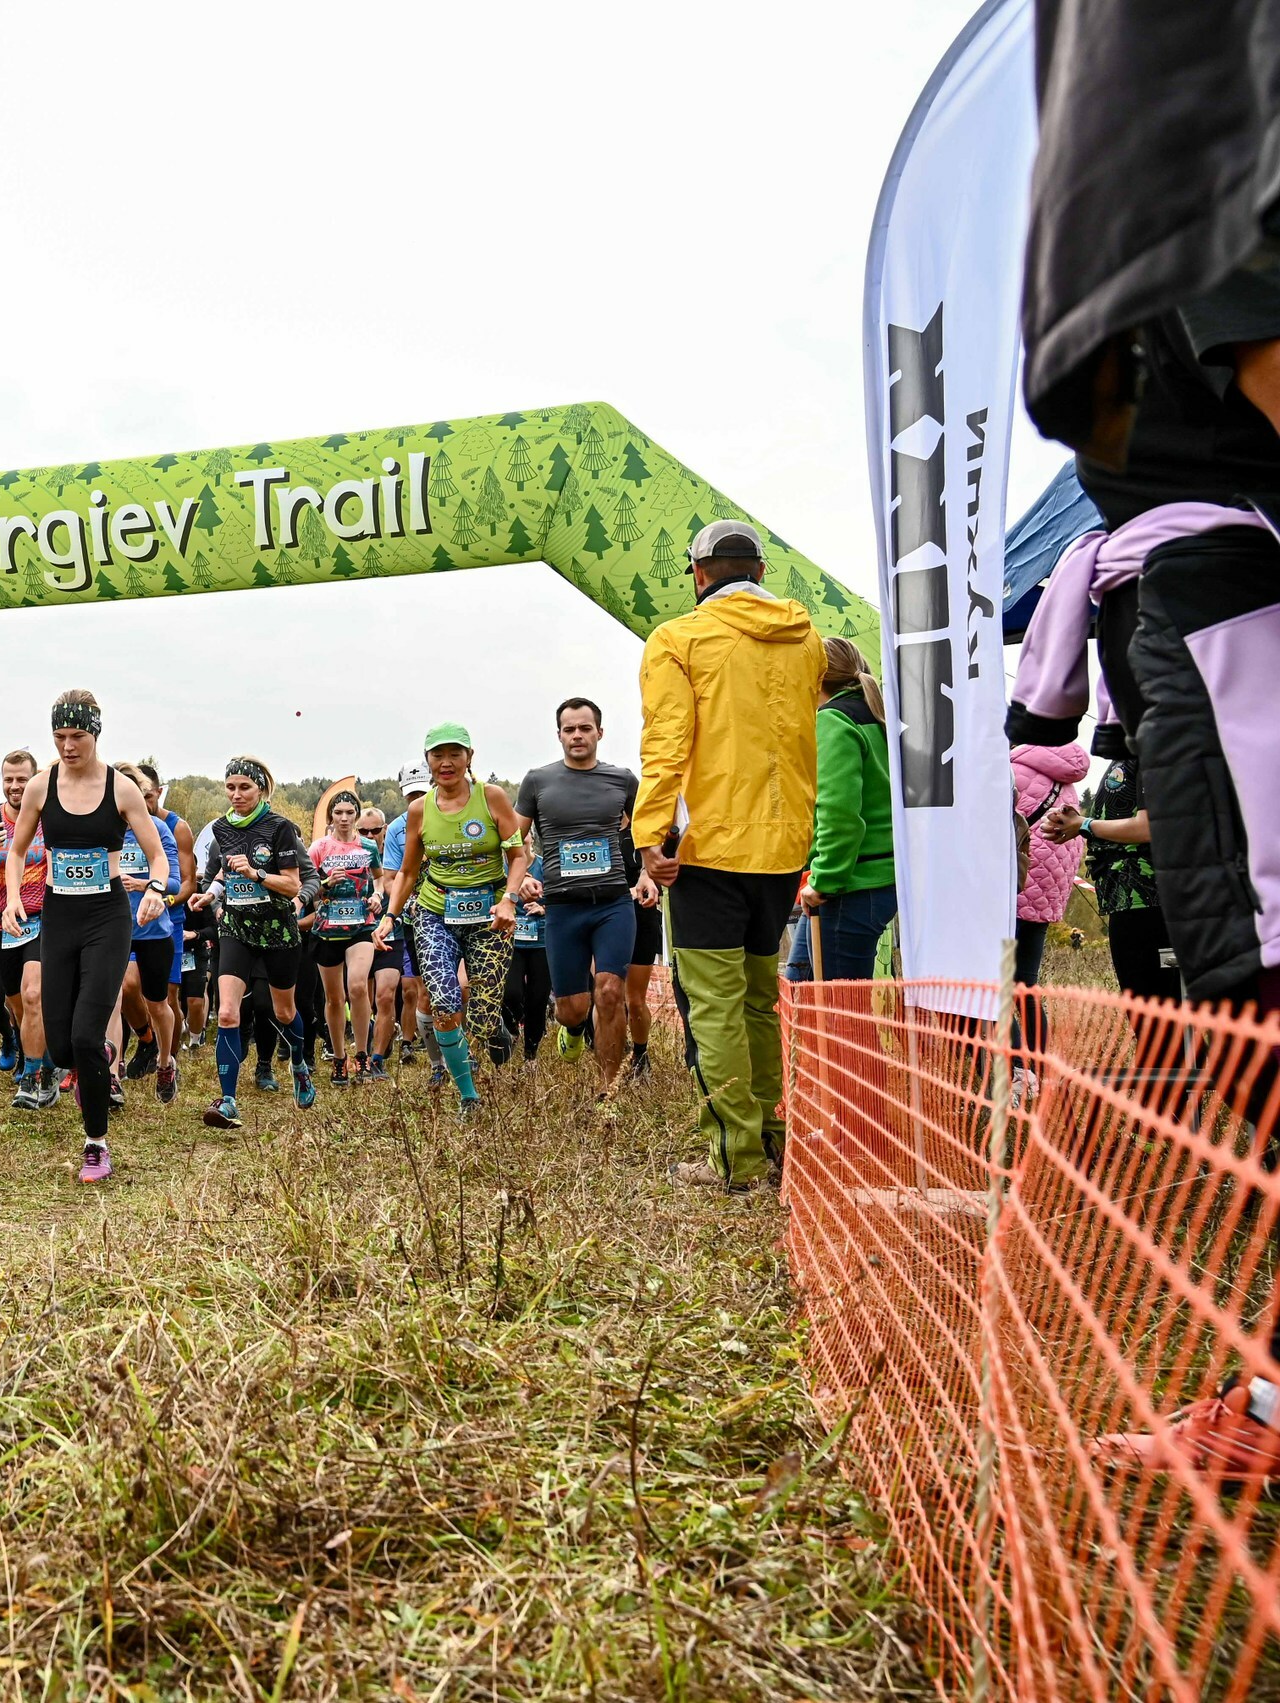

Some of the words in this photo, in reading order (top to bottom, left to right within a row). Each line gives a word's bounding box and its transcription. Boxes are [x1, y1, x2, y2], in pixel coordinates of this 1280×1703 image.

[233, 451, 431, 551] Trail
[966, 406, 995, 680] кухни
[888, 301, 954, 807] MIXX
[572, 852, 597, 864] 598
[65, 865, 95, 879] 655
[233, 883, 254, 893] 606
[338, 907, 355, 915] 632
[457, 901, 483, 912] 669
